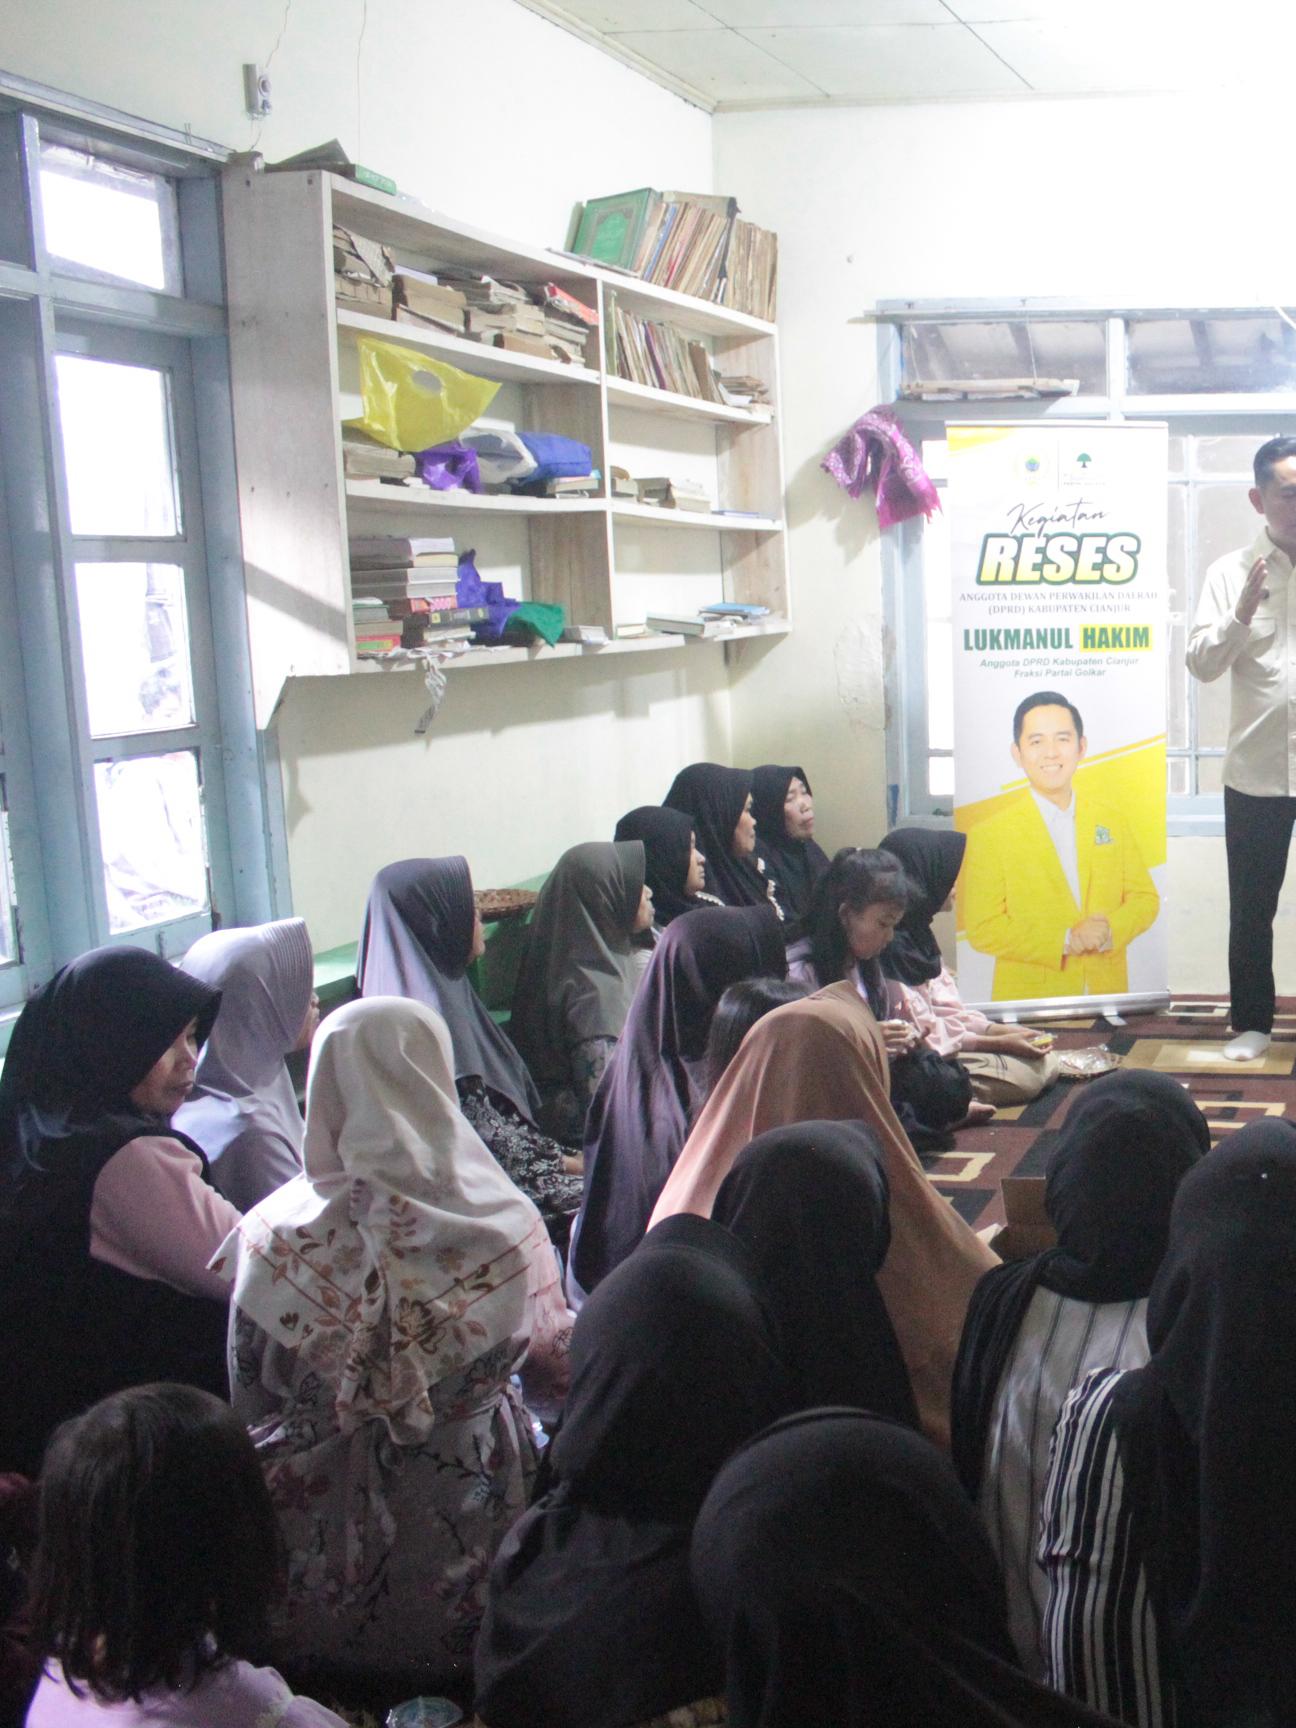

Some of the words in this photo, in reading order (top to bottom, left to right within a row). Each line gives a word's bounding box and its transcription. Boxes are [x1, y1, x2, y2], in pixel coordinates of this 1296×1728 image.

[1007, 498, 1108, 538] Kegiatan
[976, 532, 1141, 585] RESES
[959, 592, 1007, 602] ANGGOTA
[1010, 592, 1046, 601] DEWAN
[1049, 591, 1114, 600] PERWAKILAN
[988, 604, 1025, 615] (DPRD)
[1028, 604, 1087, 614] KABUPATEN
[1089, 604, 1131, 614] CIANJUR
[963, 627, 1073, 651] LUKMANUL
[1082, 626, 1149, 649] HAKIM
[979, 658, 1020, 670] Anggota
[1022, 658, 1050, 667] DPRD
[1053, 657, 1103, 668] Kabupaten
[1105, 657, 1139, 667] Cianjur
[1014, 669, 1043, 678] Fraksi
[1045, 668, 1072, 678] Partai
[1074, 668, 1106, 677] Golkar
